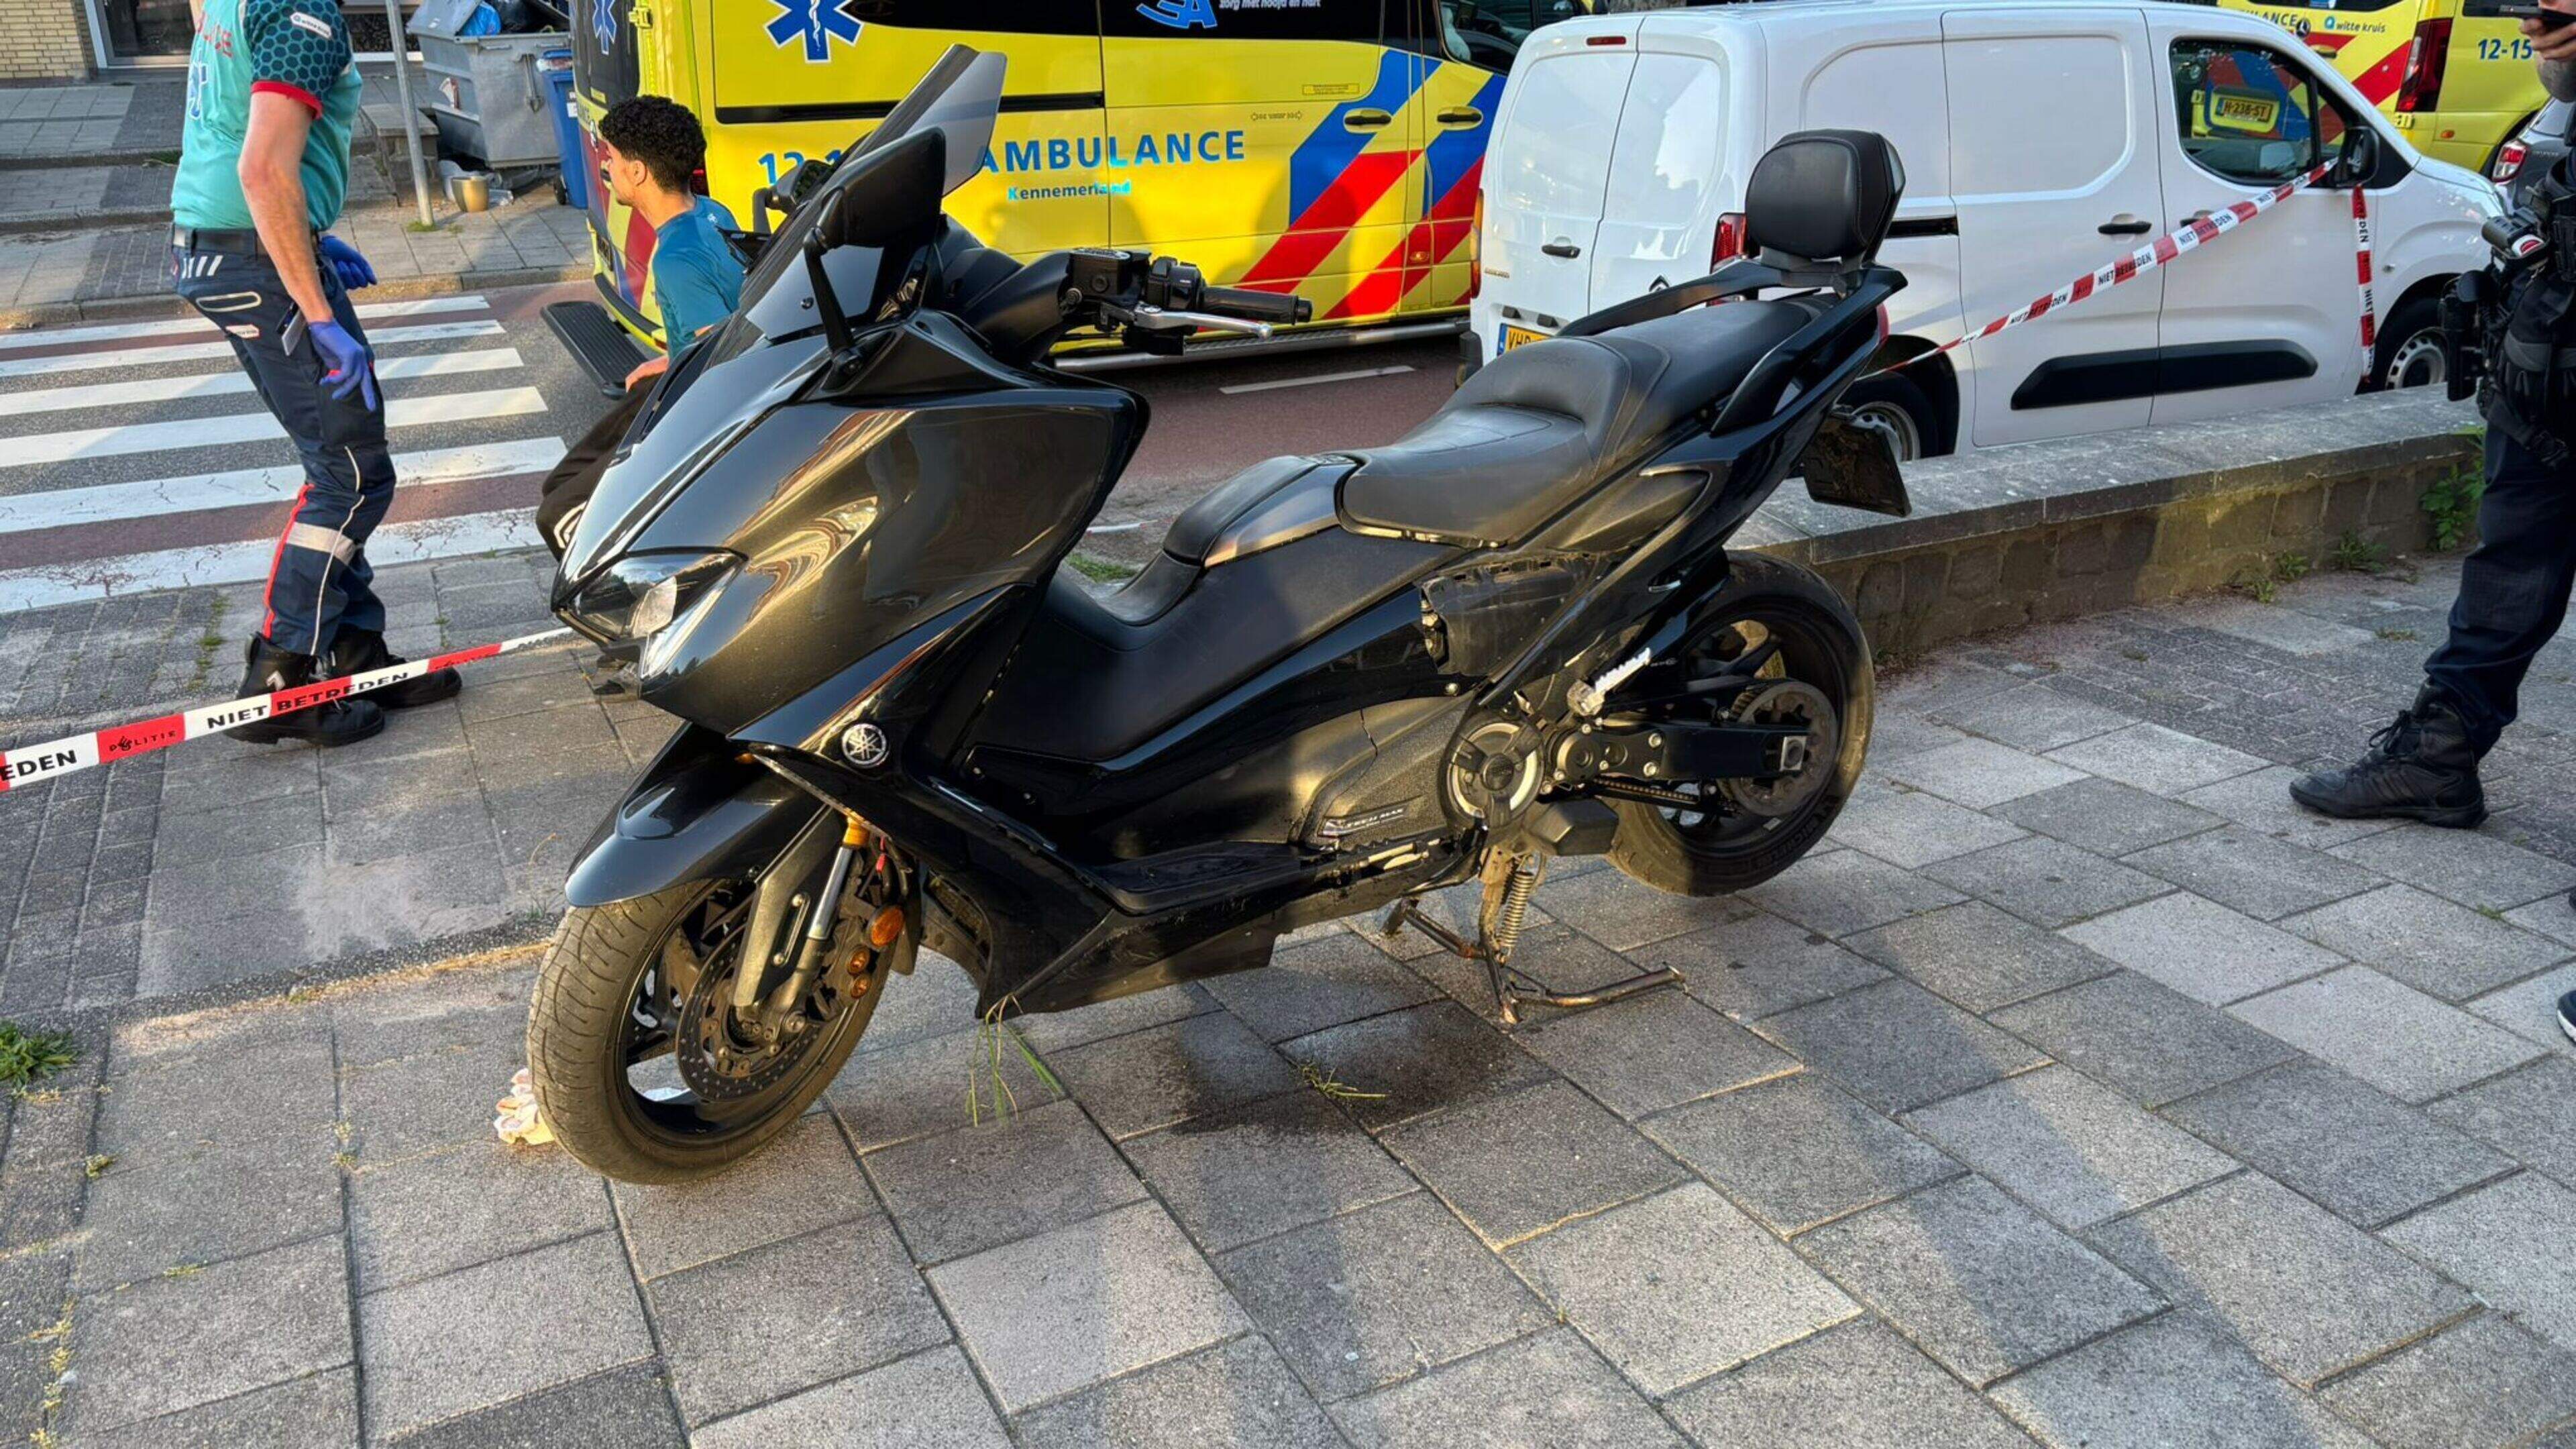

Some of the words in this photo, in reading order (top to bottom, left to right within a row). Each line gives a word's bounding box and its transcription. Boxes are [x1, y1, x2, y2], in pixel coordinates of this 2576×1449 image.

[2337, 21, 2361, 32] witte
[2362, 22, 2385, 33] kruis
[979, 130, 1245, 174] AMBULANCE
[1008, 180, 1132, 202] Kennemerland
[2098, 270, 2114, 285] NIET
[207, 704, 268, 729] NIET
[276, 672, 409, 712] BETREDEN
